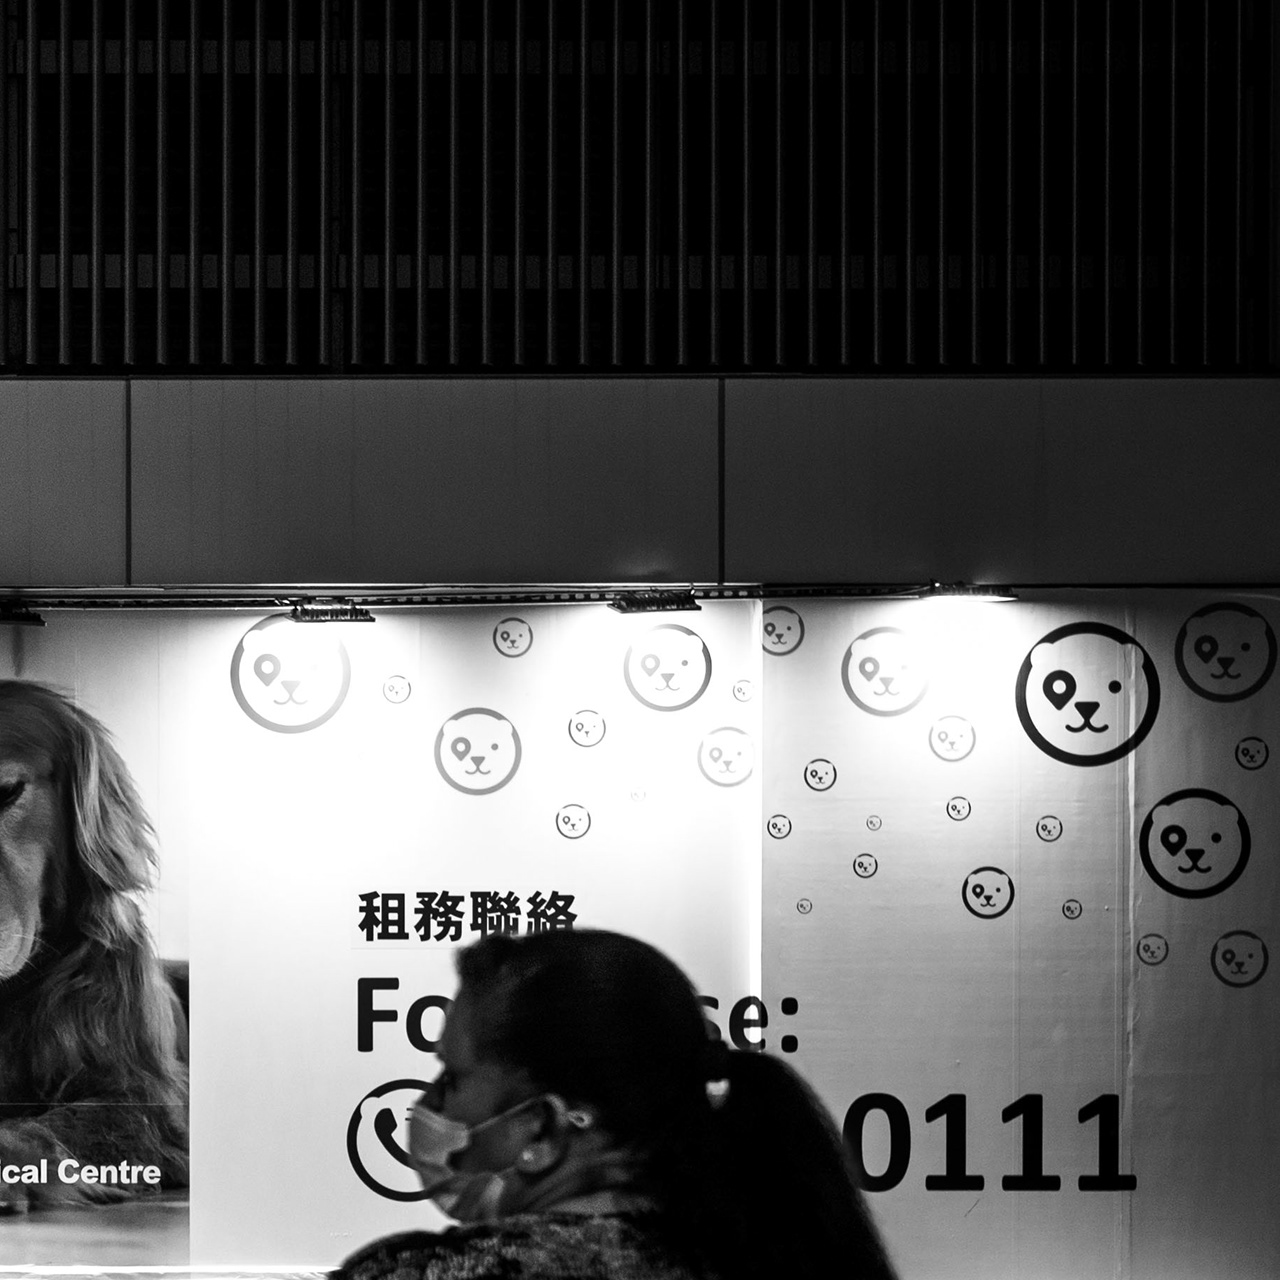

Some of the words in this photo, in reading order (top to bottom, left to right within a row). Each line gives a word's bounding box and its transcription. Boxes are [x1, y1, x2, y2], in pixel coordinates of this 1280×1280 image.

[357, 890, 578, 942] 租務聯絡
[357, 977, 454, 1053] Fo
[57, 1158, 162, 1184] Centre
[842, 1092, 1138, 1192] 0111
